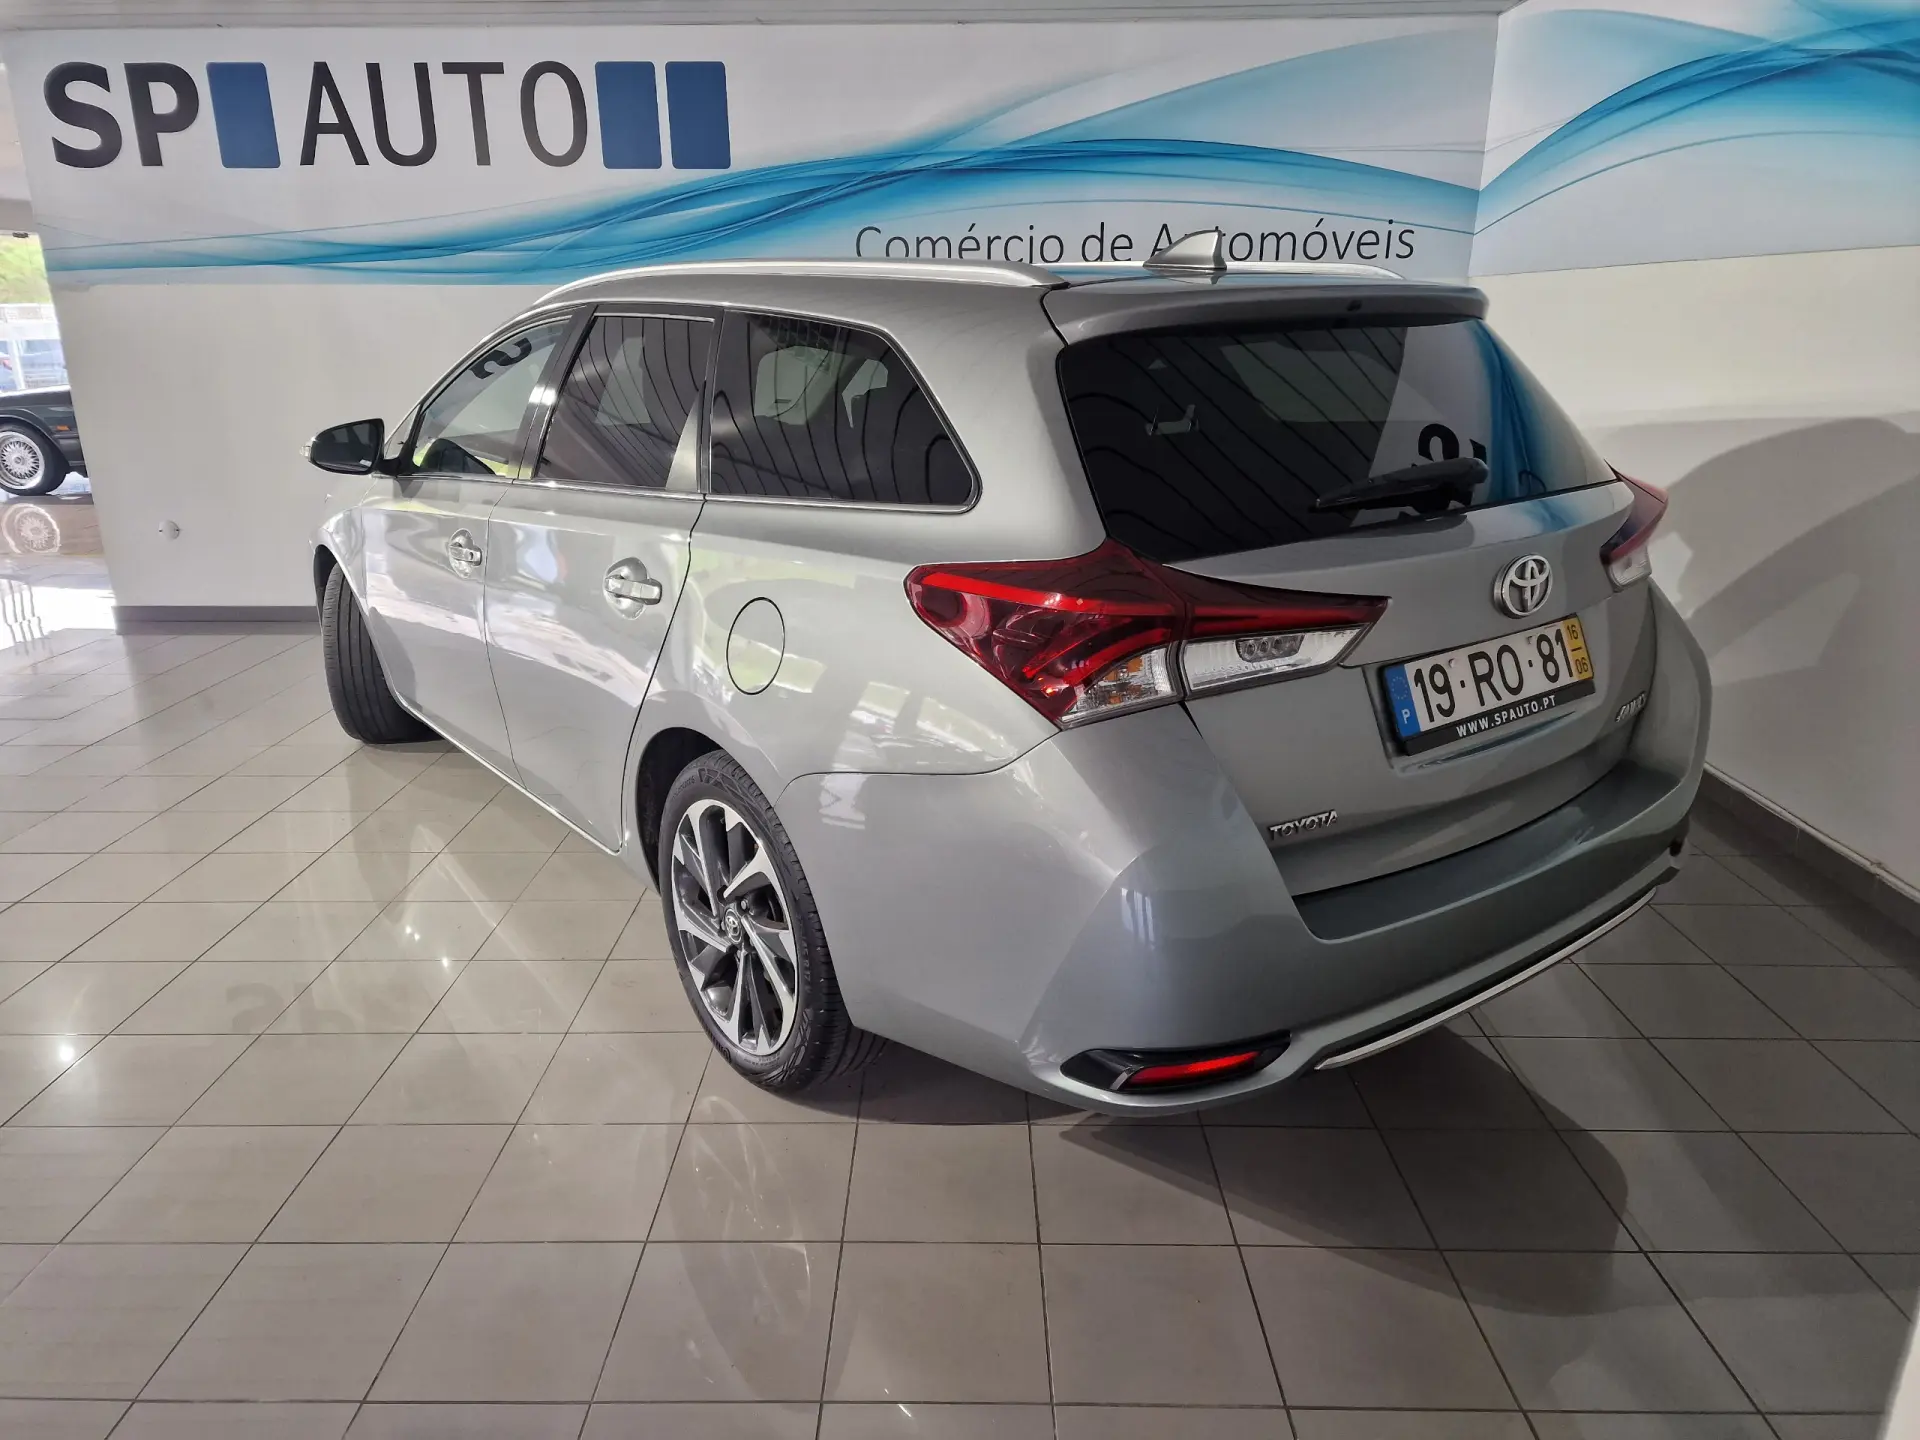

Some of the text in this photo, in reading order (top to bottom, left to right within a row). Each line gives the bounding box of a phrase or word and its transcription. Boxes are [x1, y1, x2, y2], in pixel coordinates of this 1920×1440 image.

[43, 61, 588, 168] SP AUTO
[855, 218, 1415, 265] Comércio de Aomóveis
[1566, 624, 1579, 640] 16
[1575, 656, 1589, 674] 06
[1401, 708, 1411, 725] P
[1456, 694, 1556, 738] WWW.SPAUTO.PT
[1268, 808, 1338, 840] TOYOTA
